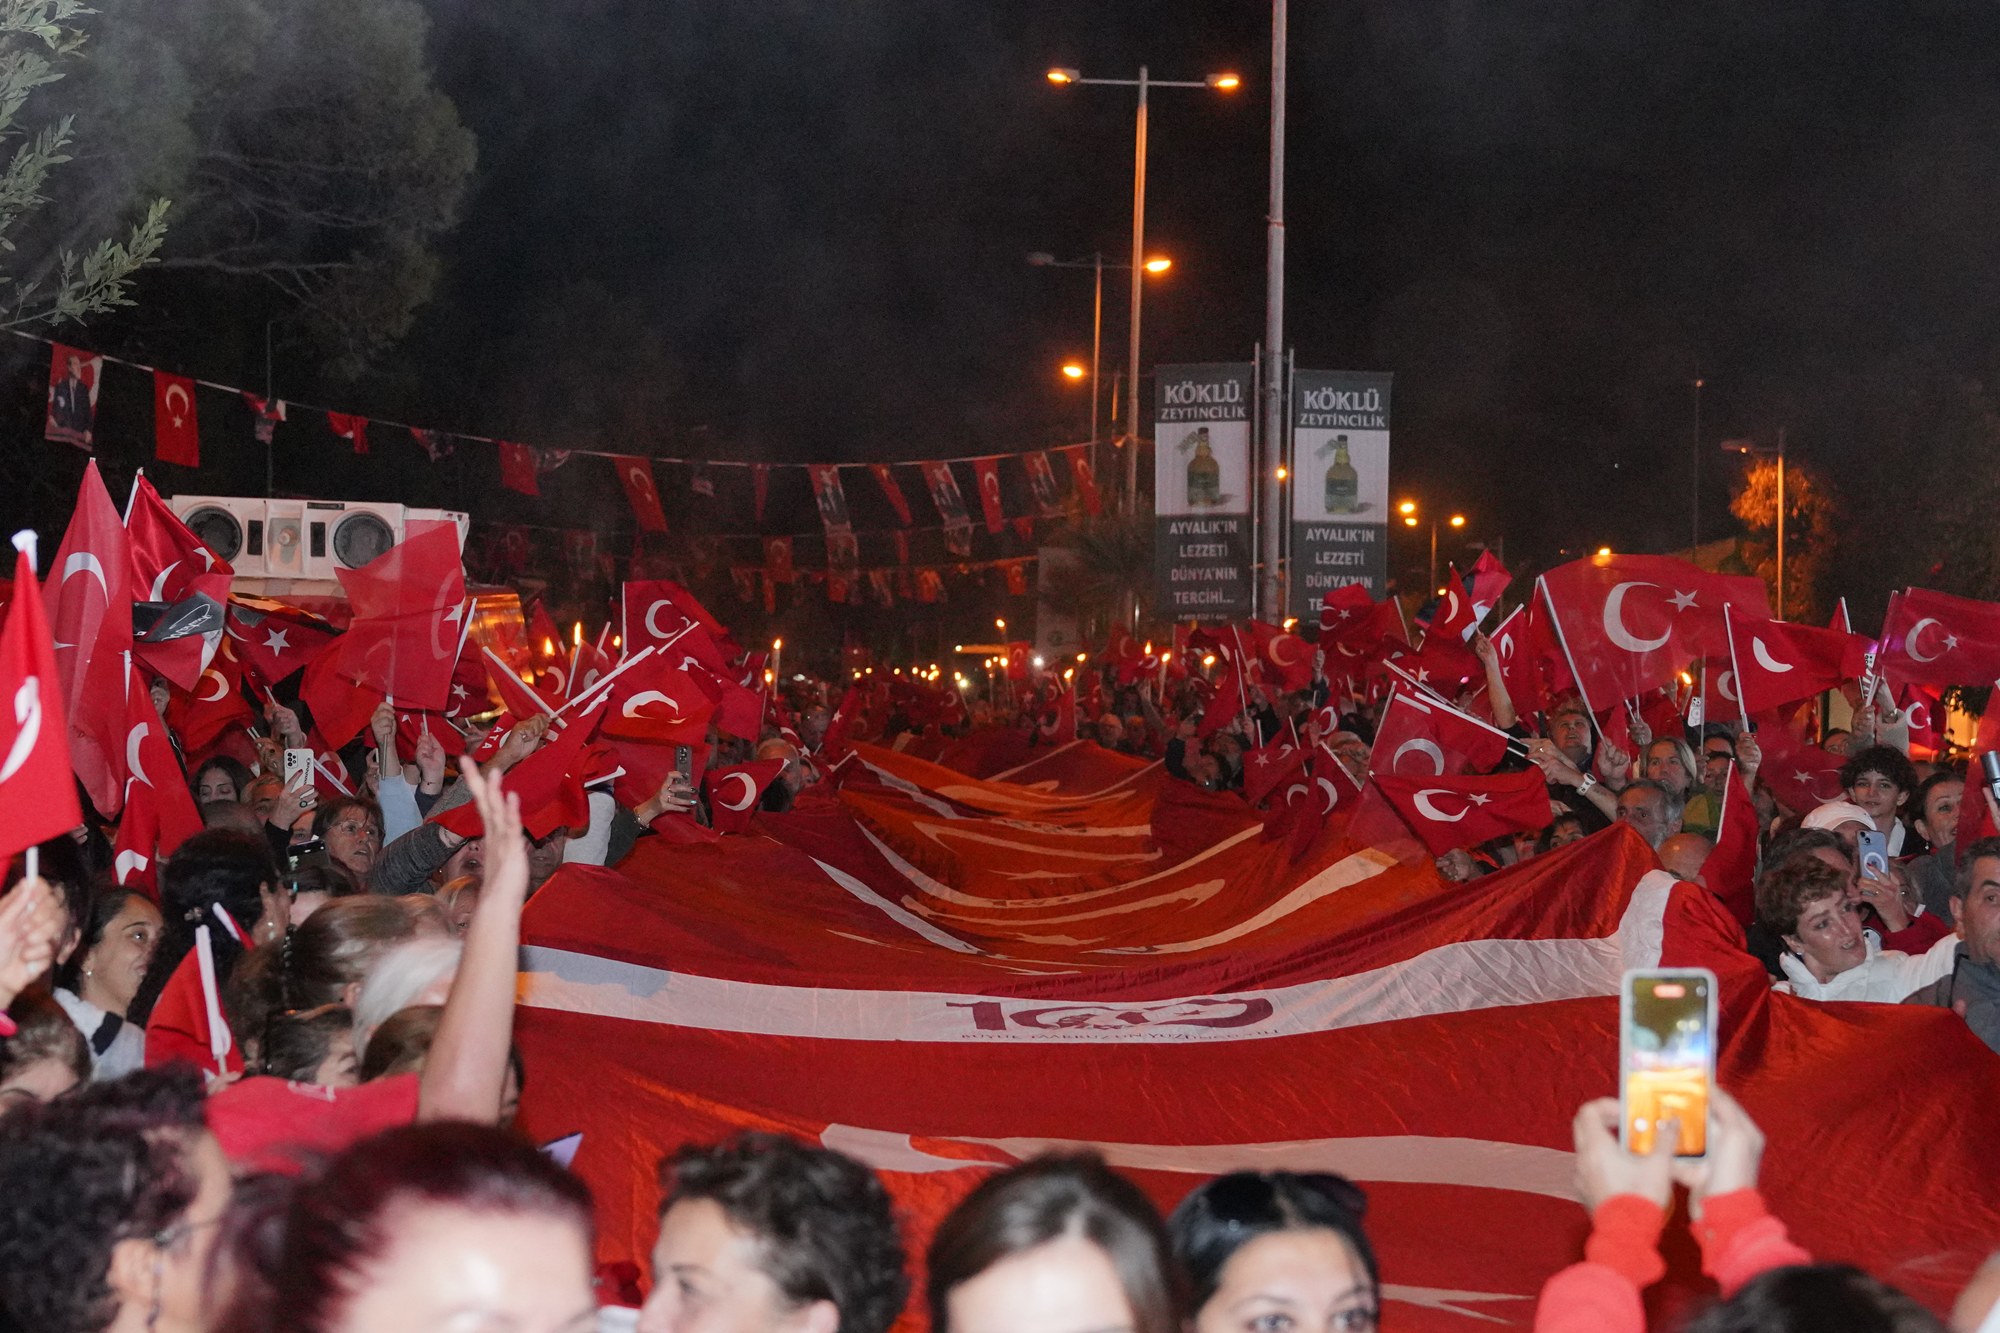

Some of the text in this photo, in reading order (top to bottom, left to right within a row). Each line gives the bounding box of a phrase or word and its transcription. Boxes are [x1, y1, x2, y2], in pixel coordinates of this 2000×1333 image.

[1161, 406, 1246, 420] ZEYTİNCİLİK
[1300, 413, 1385, 427] ZEYTİNCİLİK
[1306, 528, 1375, 542] AYVALIK'IN
[1180, 541, 1227, 557] LEZZETİ
[1315, 549, 1364, 565] LEZZETİ
